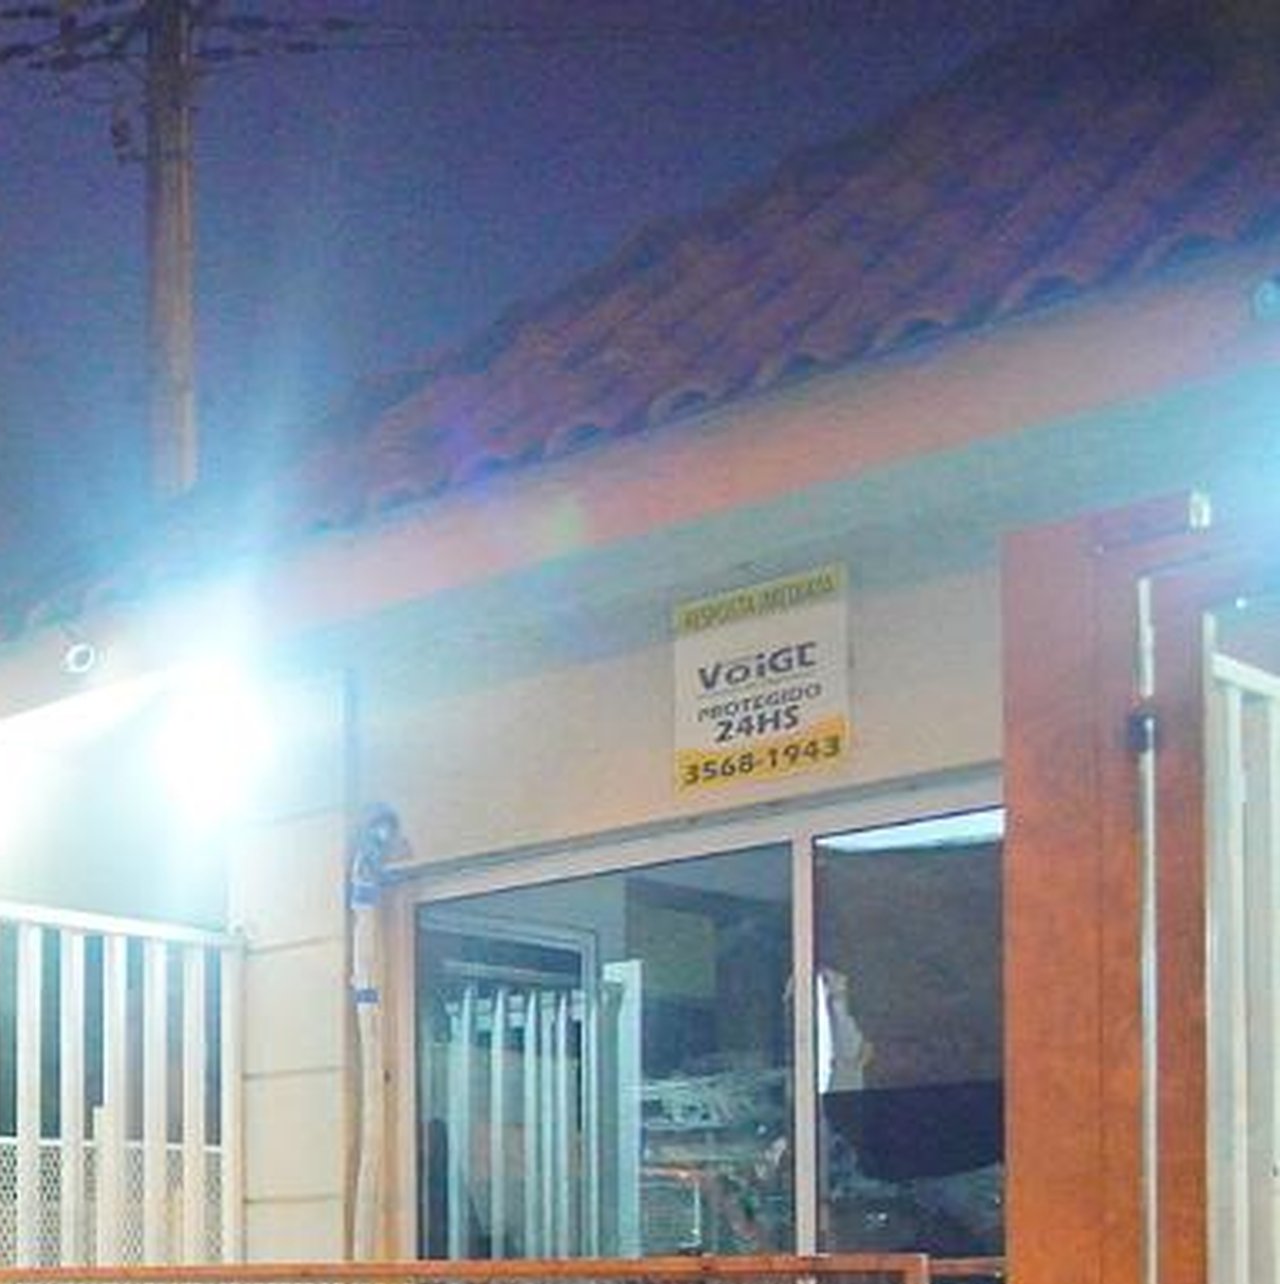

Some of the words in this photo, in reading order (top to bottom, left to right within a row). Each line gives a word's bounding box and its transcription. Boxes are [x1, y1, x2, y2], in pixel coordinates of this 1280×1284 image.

[697, 682, 822, 722] PROTEGIDO
[715, 704, 800, 743] 24HS
[683, 735, 840, 785] 3568-1943
